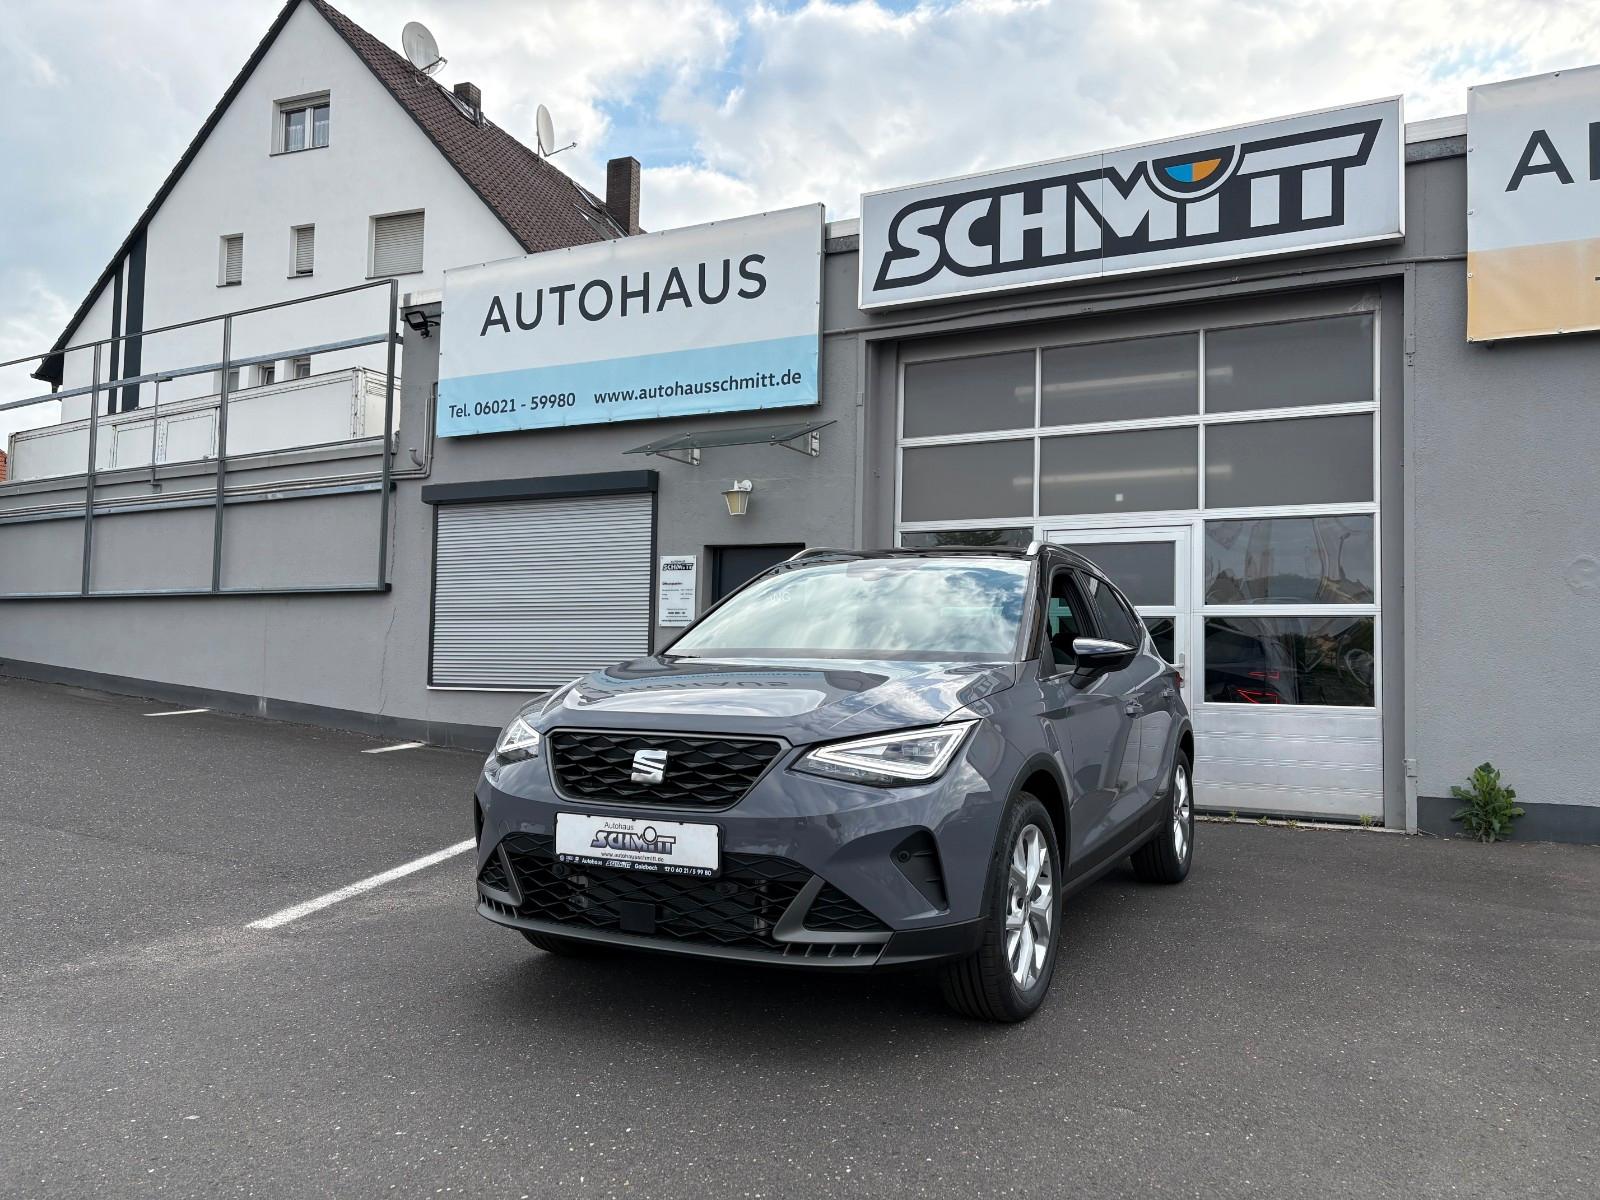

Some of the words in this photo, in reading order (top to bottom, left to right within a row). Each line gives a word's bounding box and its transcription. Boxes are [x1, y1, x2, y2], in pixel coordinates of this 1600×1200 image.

[873, 118, 1383, 291] SCHMITT
[479, 253, 767, 337] AUTOHAUS
[449, 404, 471, 418] Tel.
[474, 398, 516, 416] 06021
[530, 392, 576, 411] 59980
[594, 369, 801, 404] www.autohausschmitt.de
[590, 826, 676, 855] SCHMITT
[604, 821, 634, 831] Autohaus
